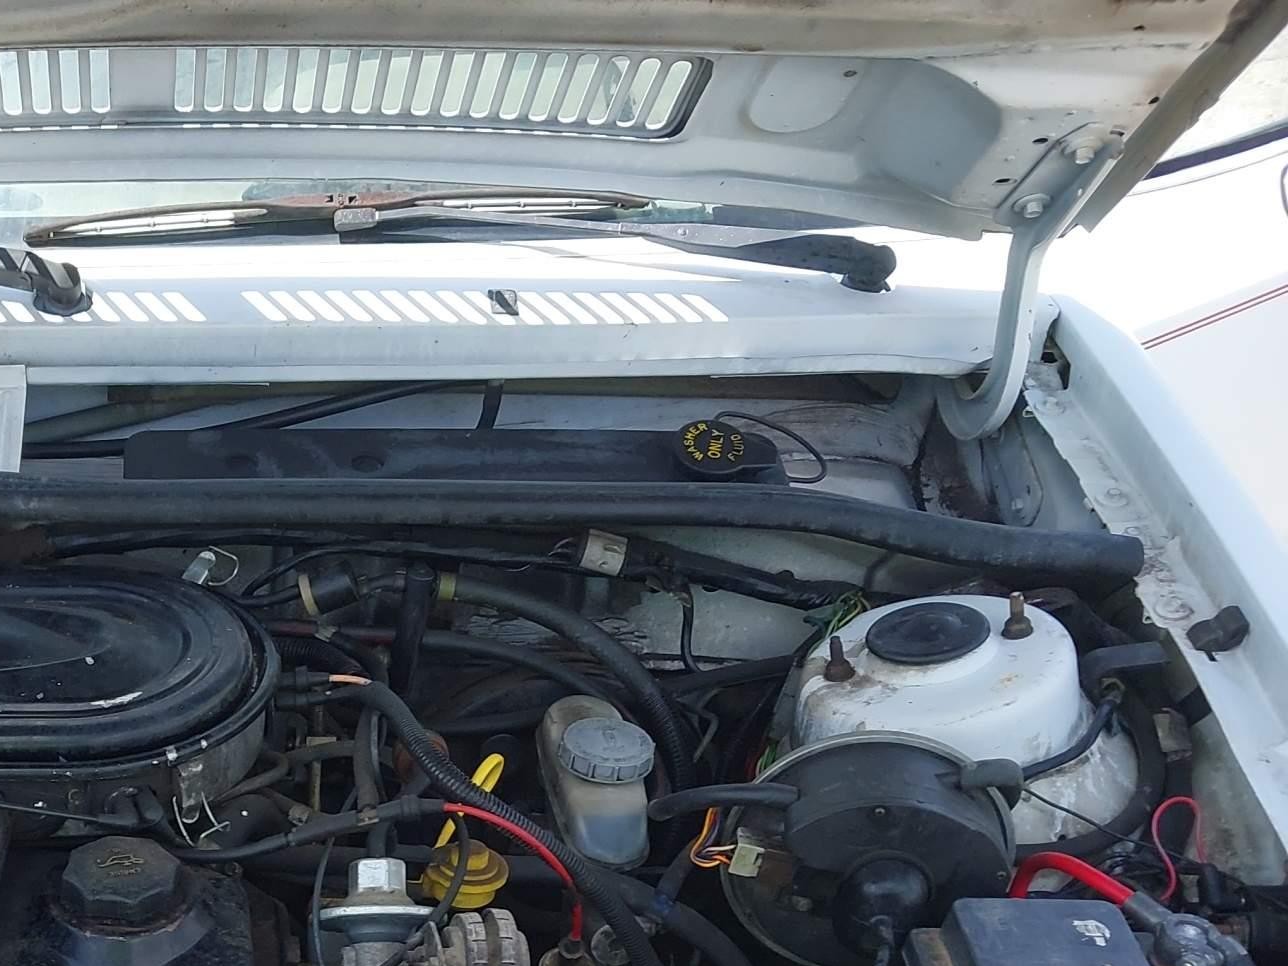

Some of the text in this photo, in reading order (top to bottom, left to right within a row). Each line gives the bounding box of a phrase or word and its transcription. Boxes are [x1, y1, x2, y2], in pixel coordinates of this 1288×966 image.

[683, 423, 709, 461] WASHER
[707, 429, 725, 459] ONLY
[727, 434, 745, 462] FLUID
